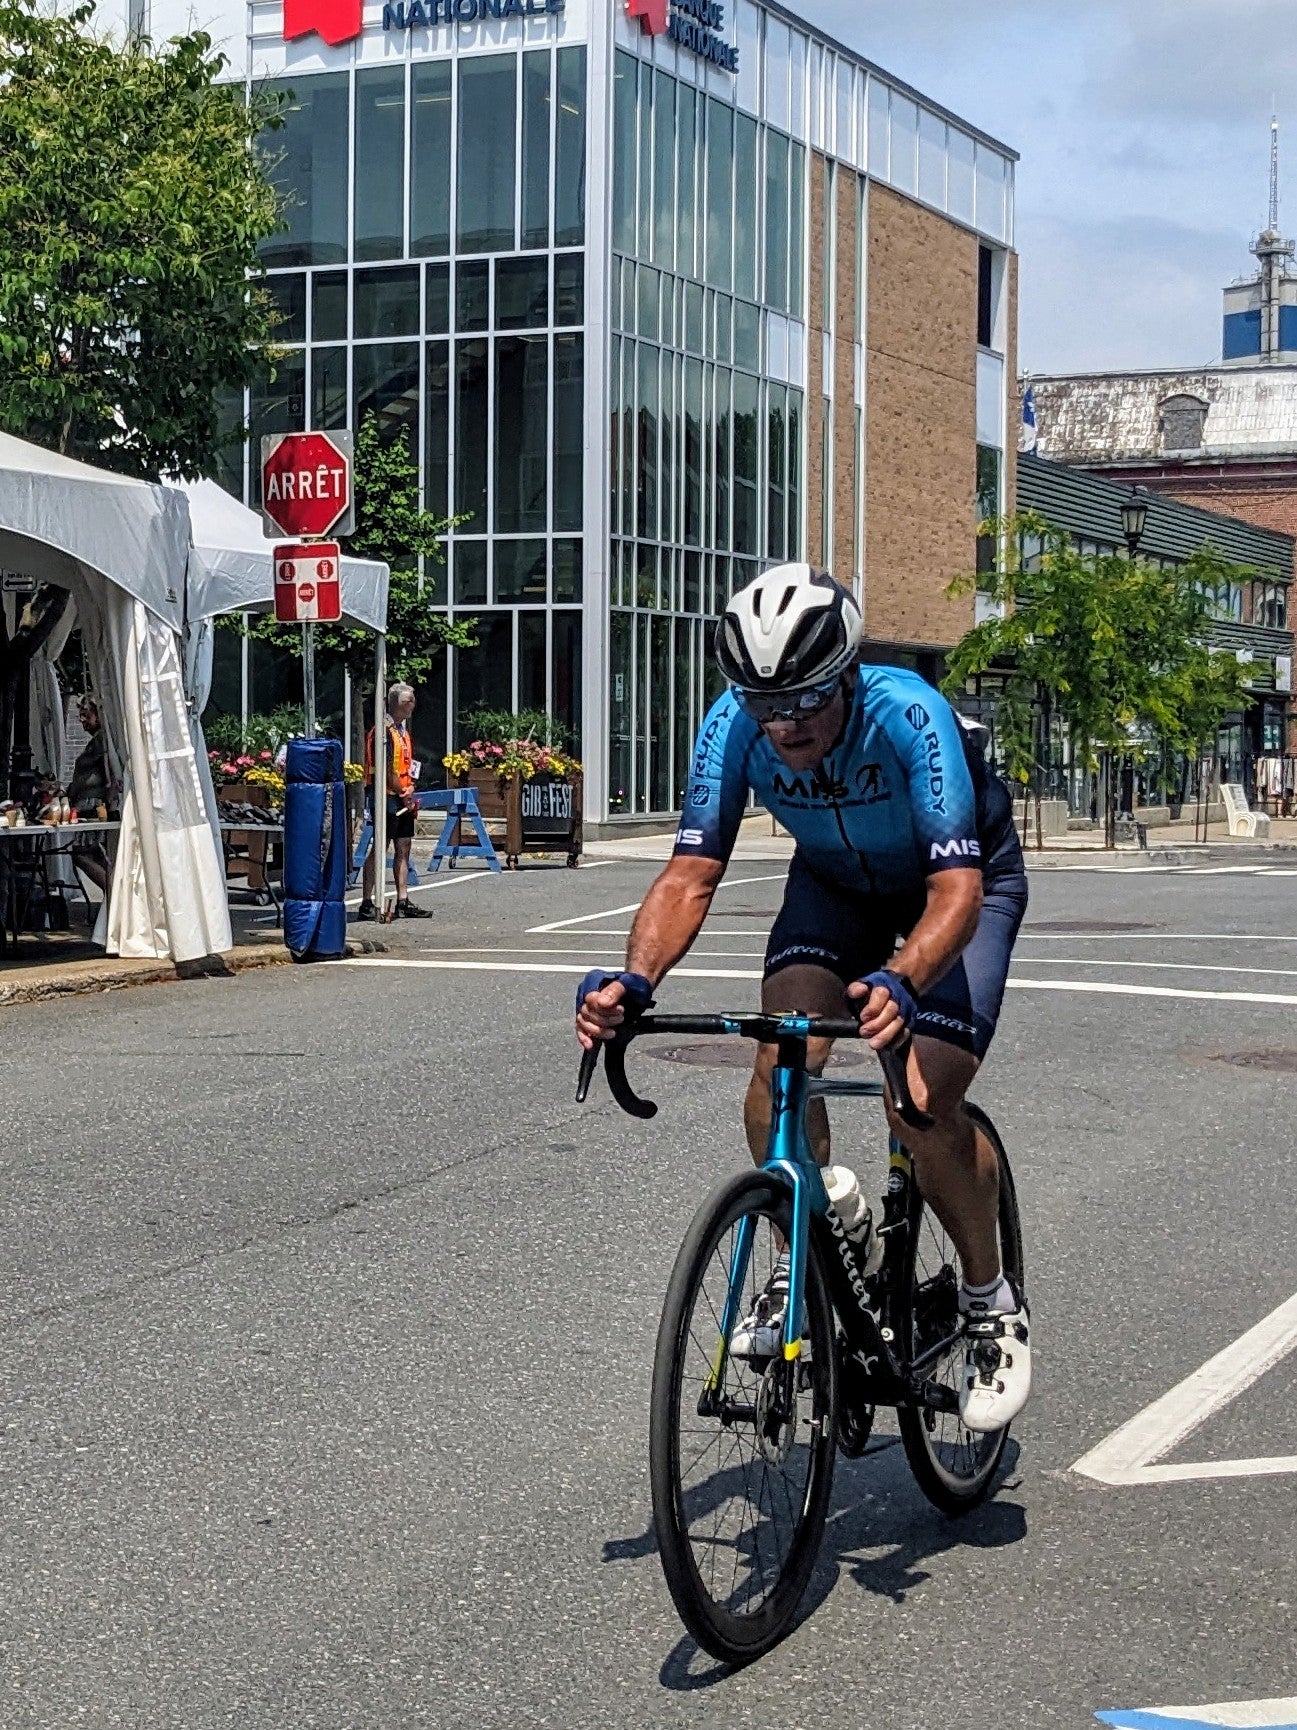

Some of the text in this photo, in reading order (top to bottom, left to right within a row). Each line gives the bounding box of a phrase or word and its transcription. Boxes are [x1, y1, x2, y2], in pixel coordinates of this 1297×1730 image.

[670, 0, 725, 32] NQUE
[669, 14, 740, 74] NATIONALE
[267, 464, 344, 501] ARRÊT
[695, 704, 731, 778] RUDY
[925, 731, 946, 816] RUDY
[521, 783, 542, 817] GIB
[548, 782, 574, 818] FEST
[676, 828, 704, 845] IS
[930, 839, 981, 860] MIS
